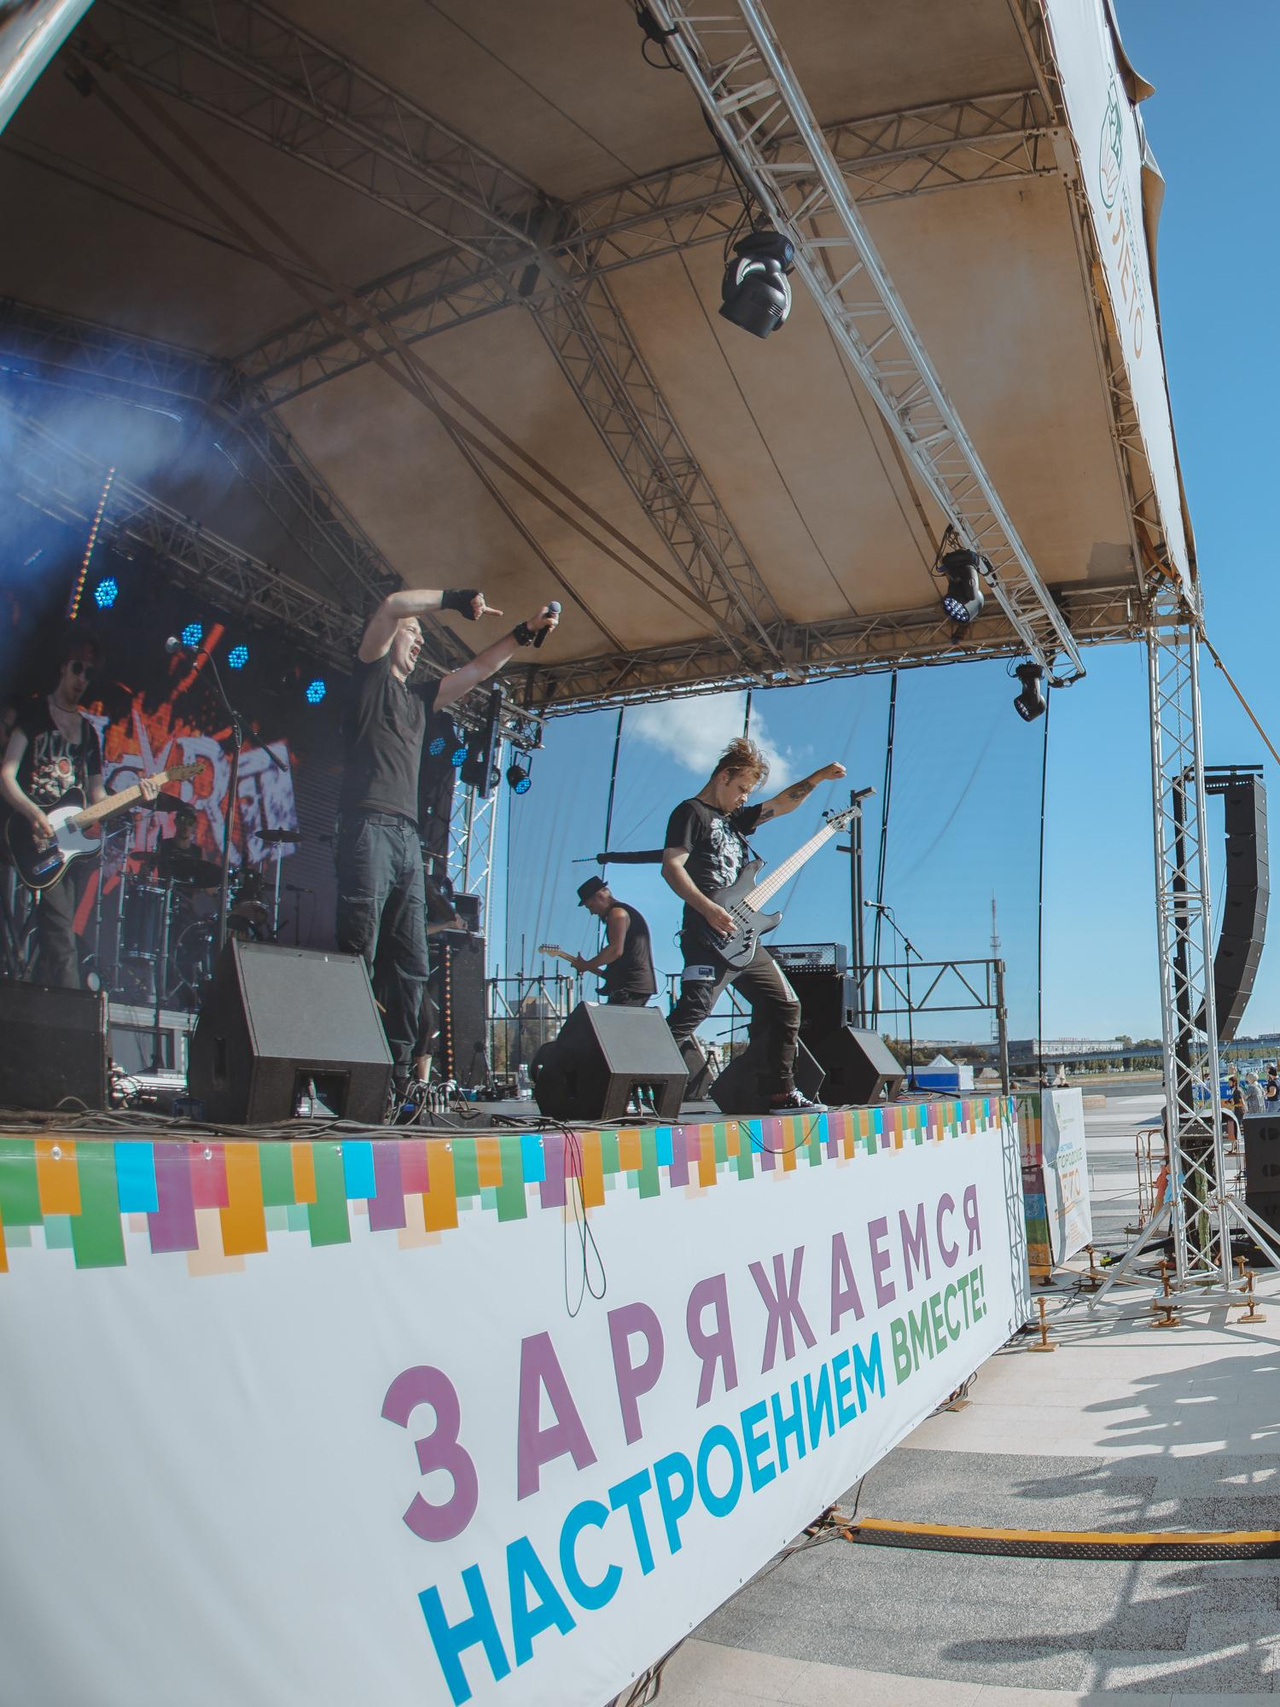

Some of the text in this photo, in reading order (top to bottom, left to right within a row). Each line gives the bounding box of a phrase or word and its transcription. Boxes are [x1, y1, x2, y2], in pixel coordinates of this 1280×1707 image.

[381, 1183, 982, 1543] ЗАРЯЖАЕМСЯ
[417, 1264, 988, 1707] НАСТРОЕНИЕМ ВМЕСТЕ!
